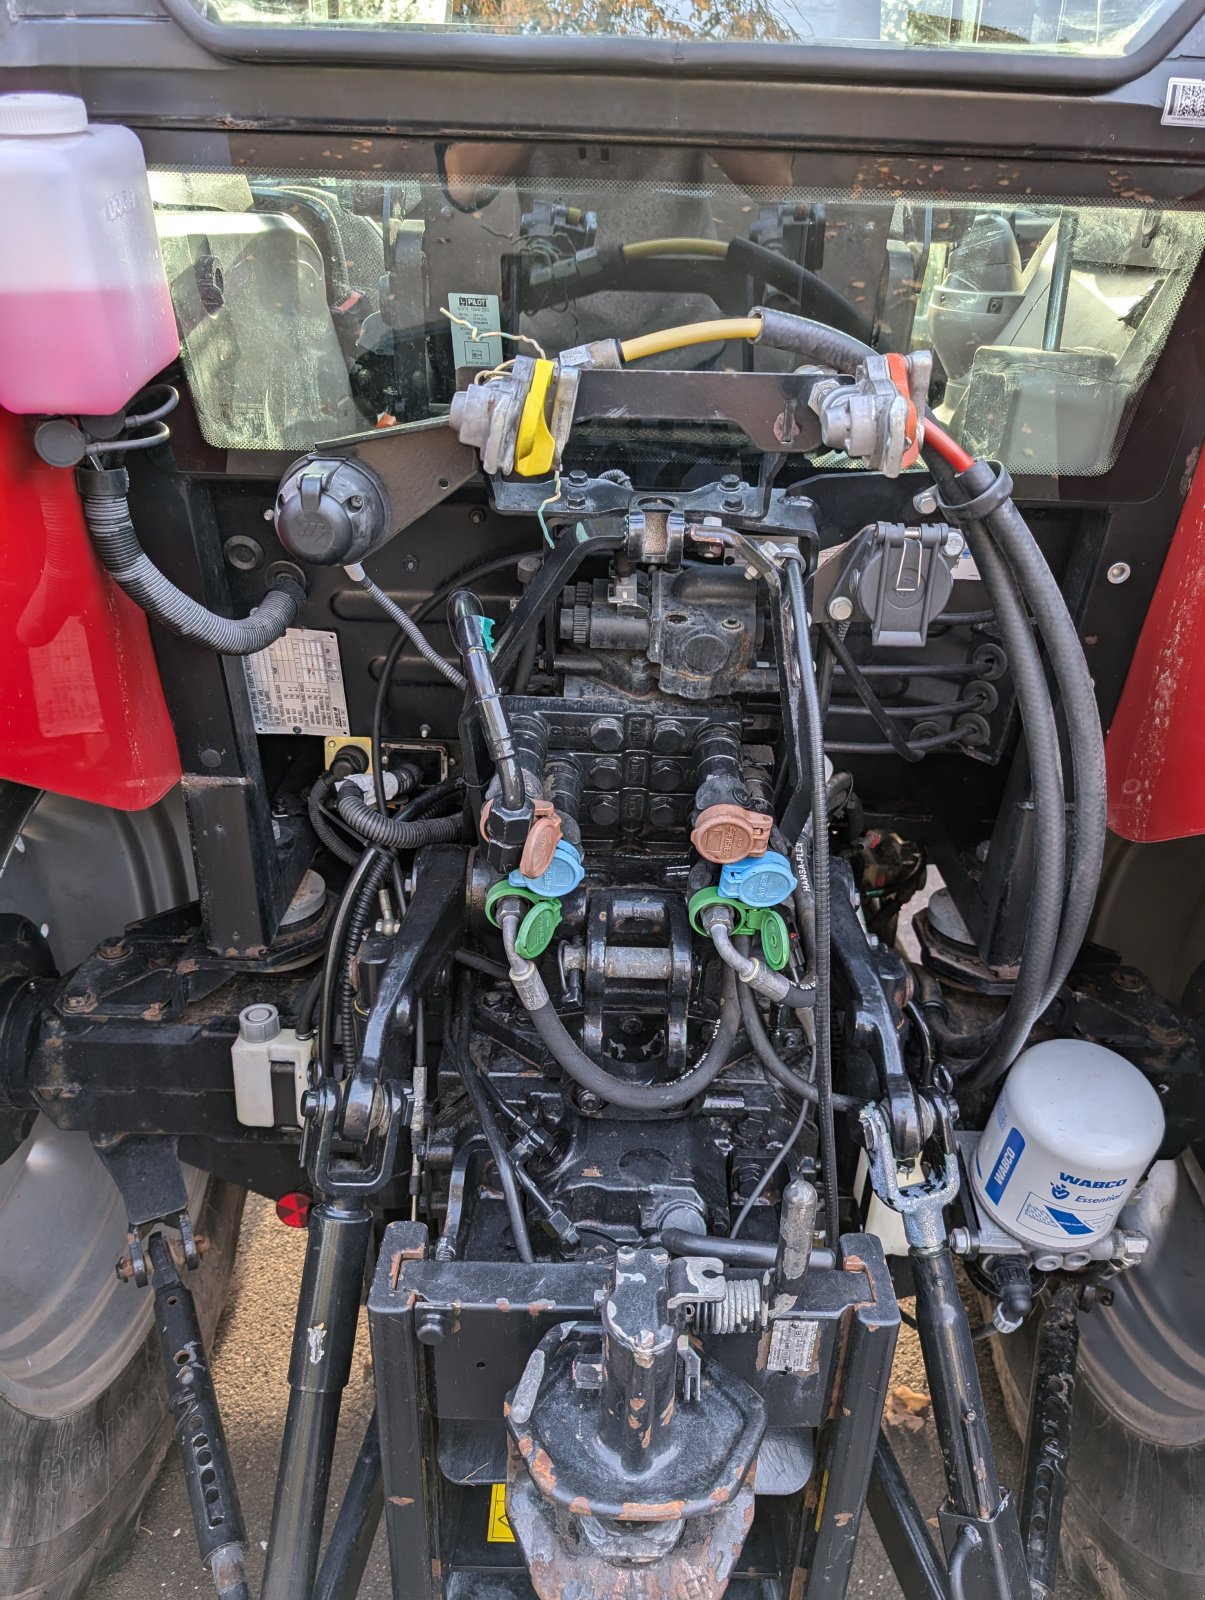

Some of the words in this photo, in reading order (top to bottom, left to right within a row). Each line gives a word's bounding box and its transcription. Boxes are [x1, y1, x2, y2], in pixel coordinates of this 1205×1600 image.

[795, 842, 812, 892] HANSA-FLEX
[994, 1146, 1016, 1185] WABCO
[1059, 1171, 1128, 1189] WABCO
[1075, 1190, 1124, 1204] Essential
